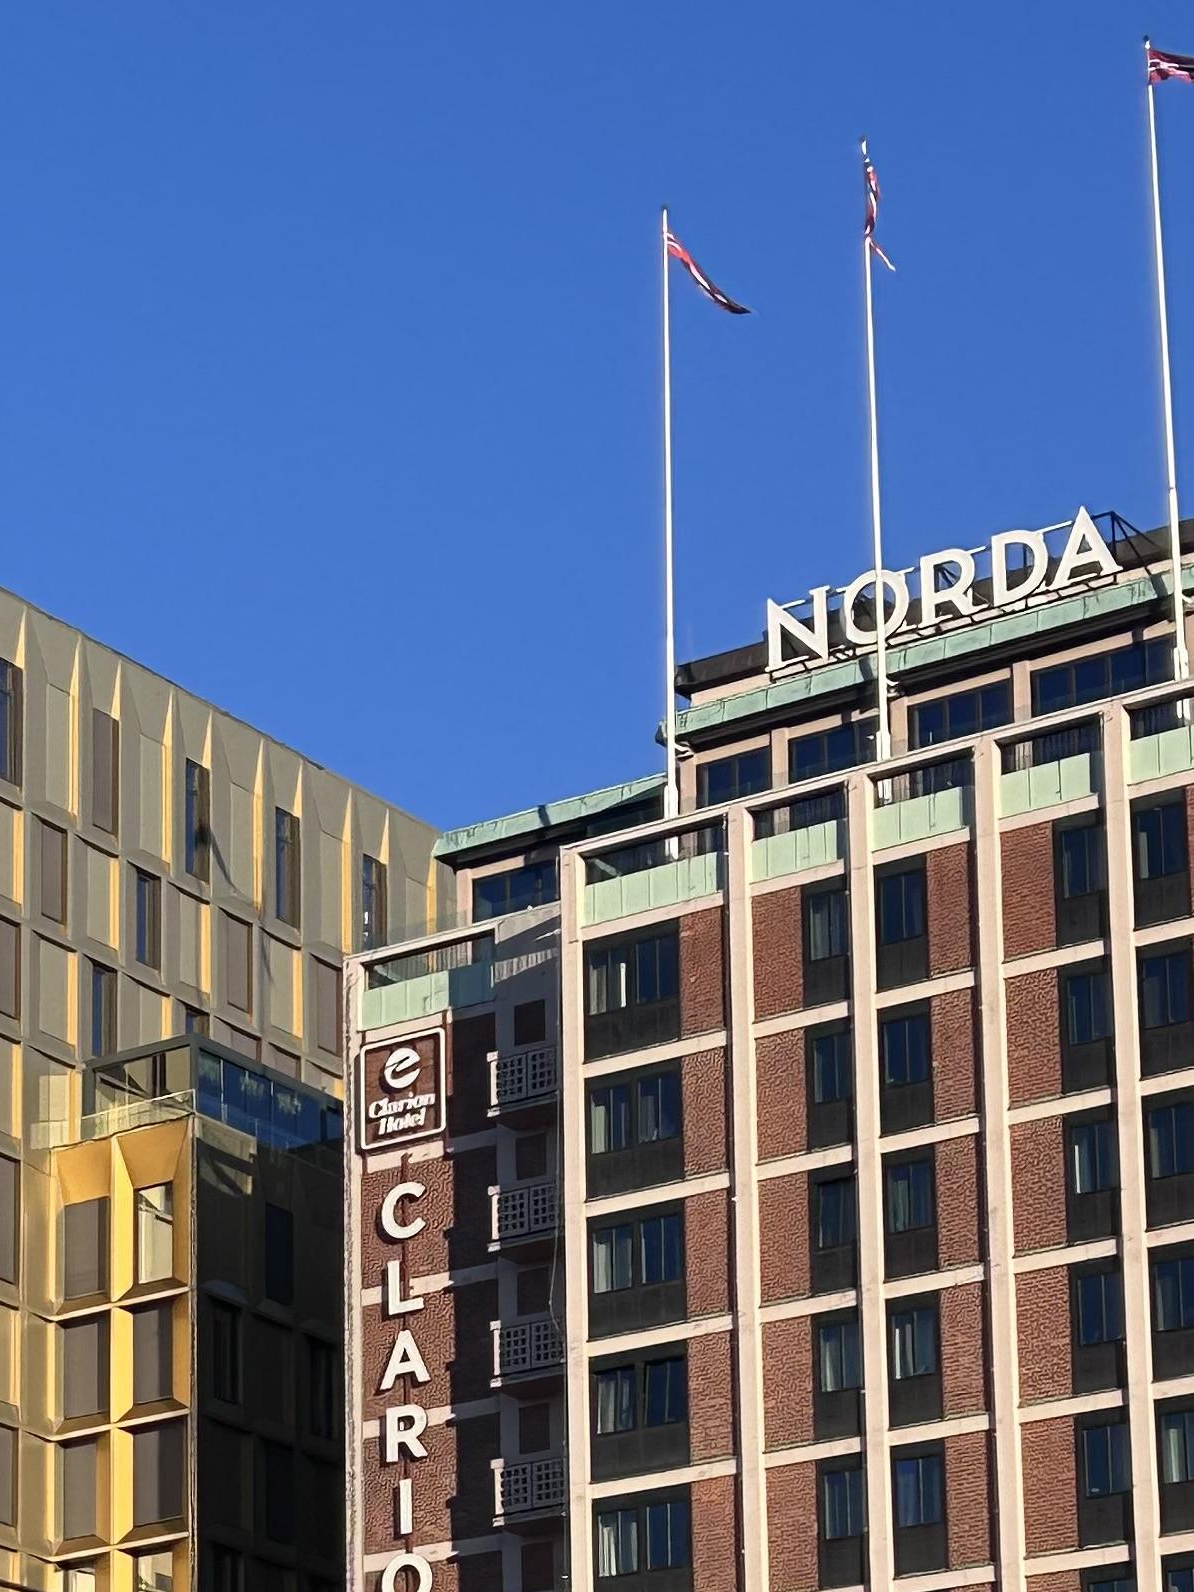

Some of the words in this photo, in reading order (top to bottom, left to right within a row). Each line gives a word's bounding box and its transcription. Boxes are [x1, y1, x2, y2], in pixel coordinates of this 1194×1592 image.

[765, 505, 1123, 674] NORDA
[368, 1091, 436, 1119] Clarion
[378, 1106, 426, 1135] Hotel
